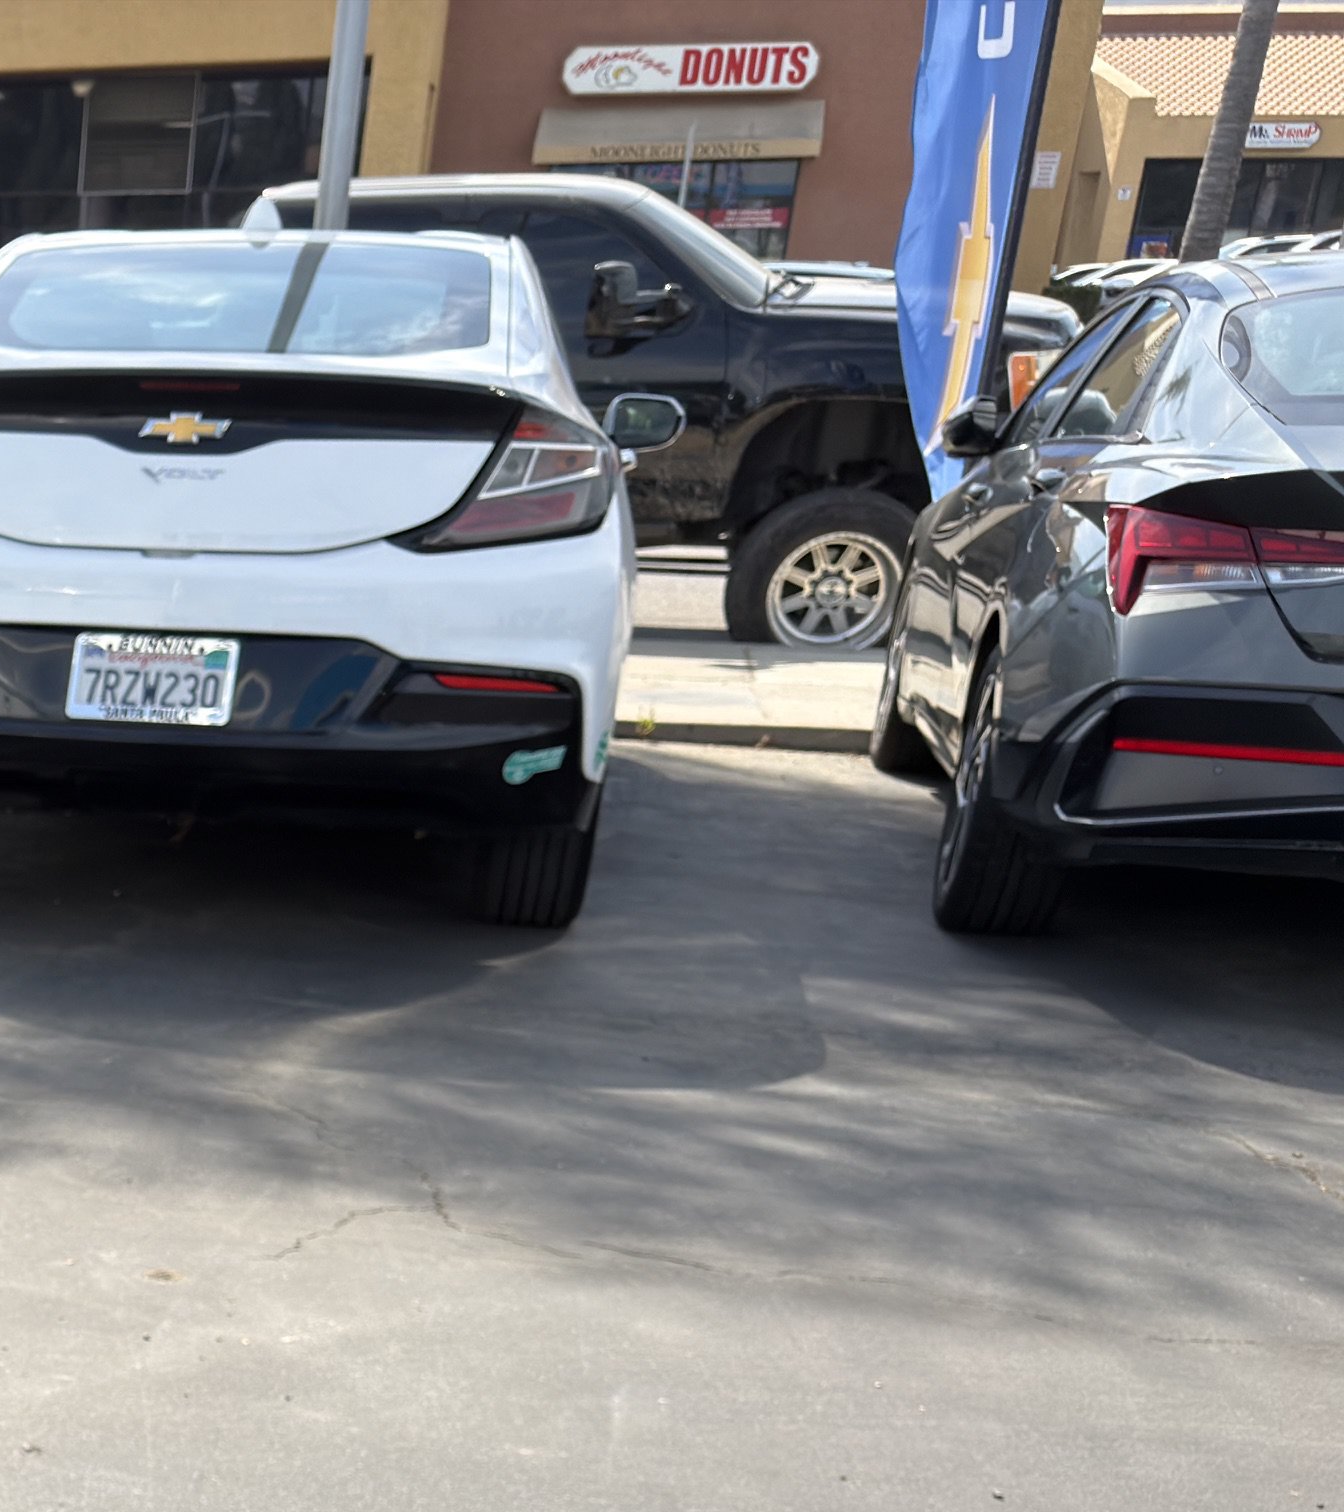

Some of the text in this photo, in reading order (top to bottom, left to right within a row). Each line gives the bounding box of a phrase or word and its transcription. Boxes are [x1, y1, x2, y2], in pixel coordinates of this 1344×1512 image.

[678, 46, 809, 86] DONUTS
[693, 143, 761, 156] DONUTS
[84, 667, 220, 709] 7RZW230
